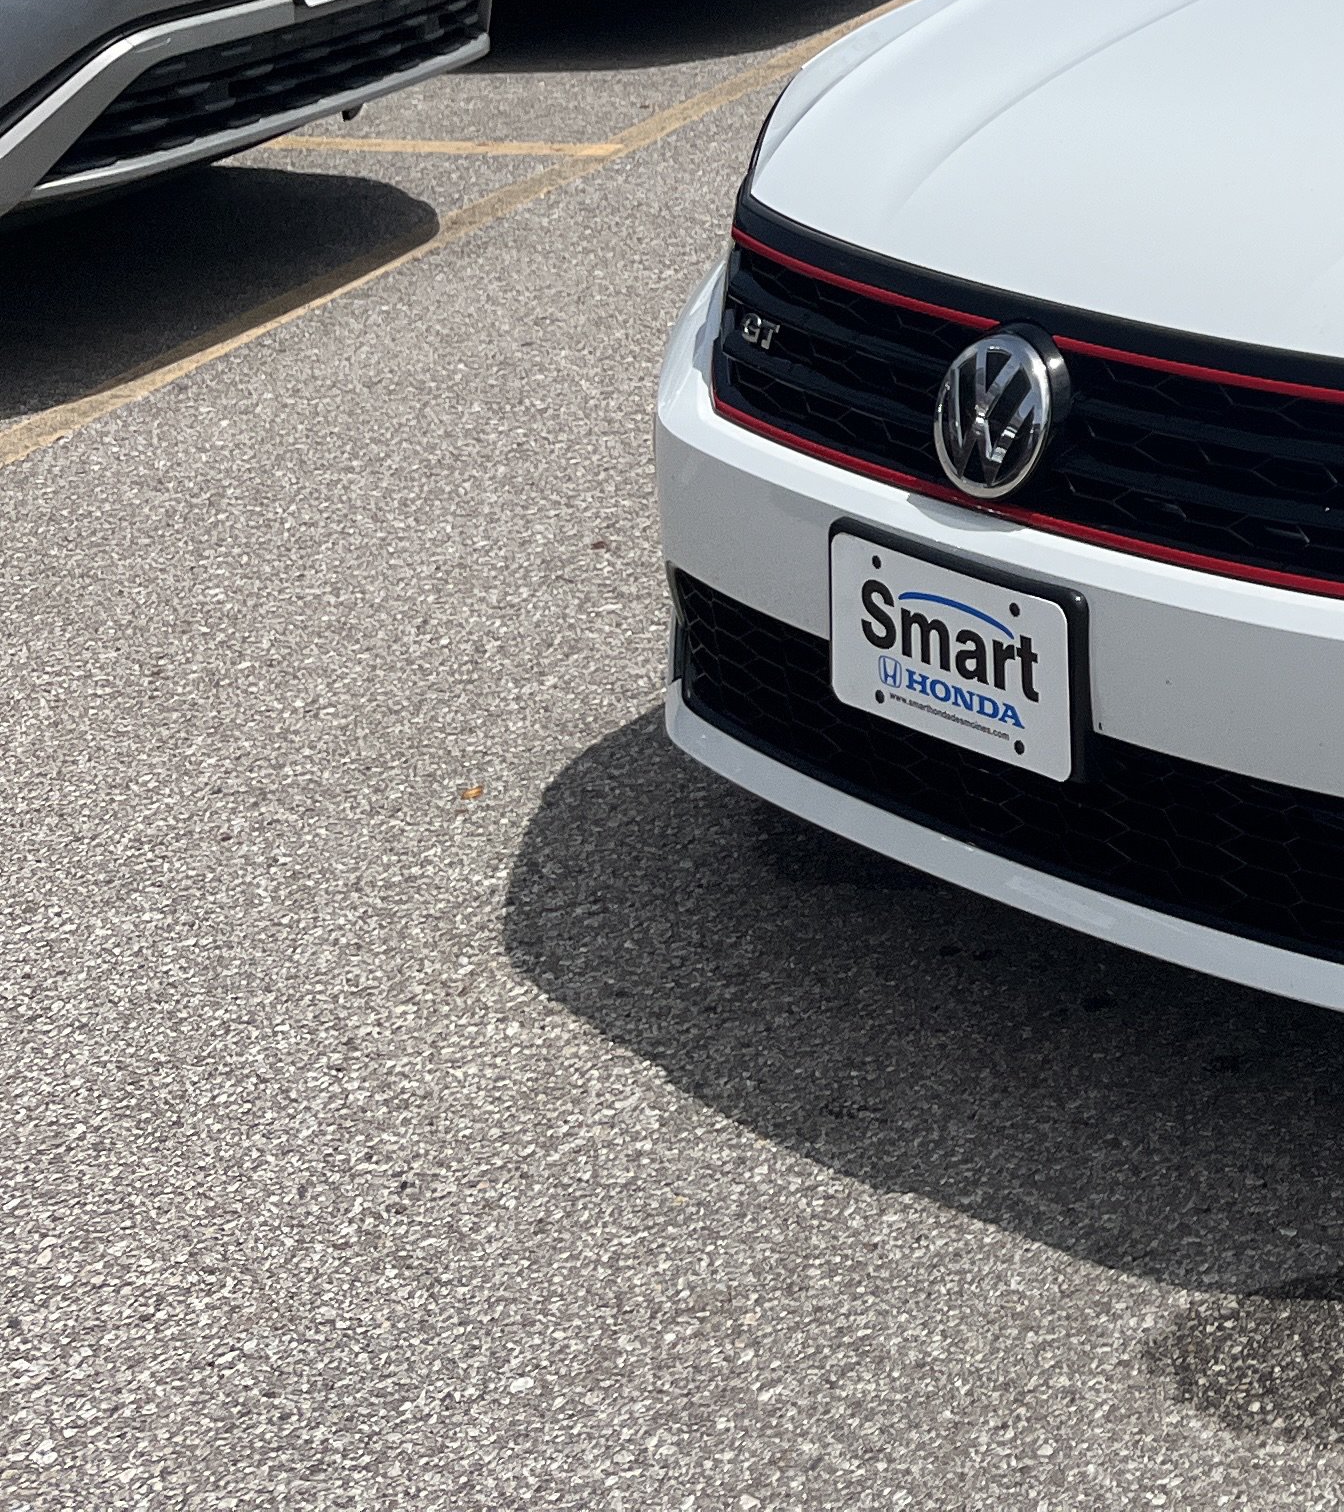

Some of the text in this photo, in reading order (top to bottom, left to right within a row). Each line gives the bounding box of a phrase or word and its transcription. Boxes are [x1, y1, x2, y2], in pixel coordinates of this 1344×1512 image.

[741, 312, 780, 350] GT
[861, 578, 1040, 702] Smart
[906, 668, 1025, 729] HONDA
